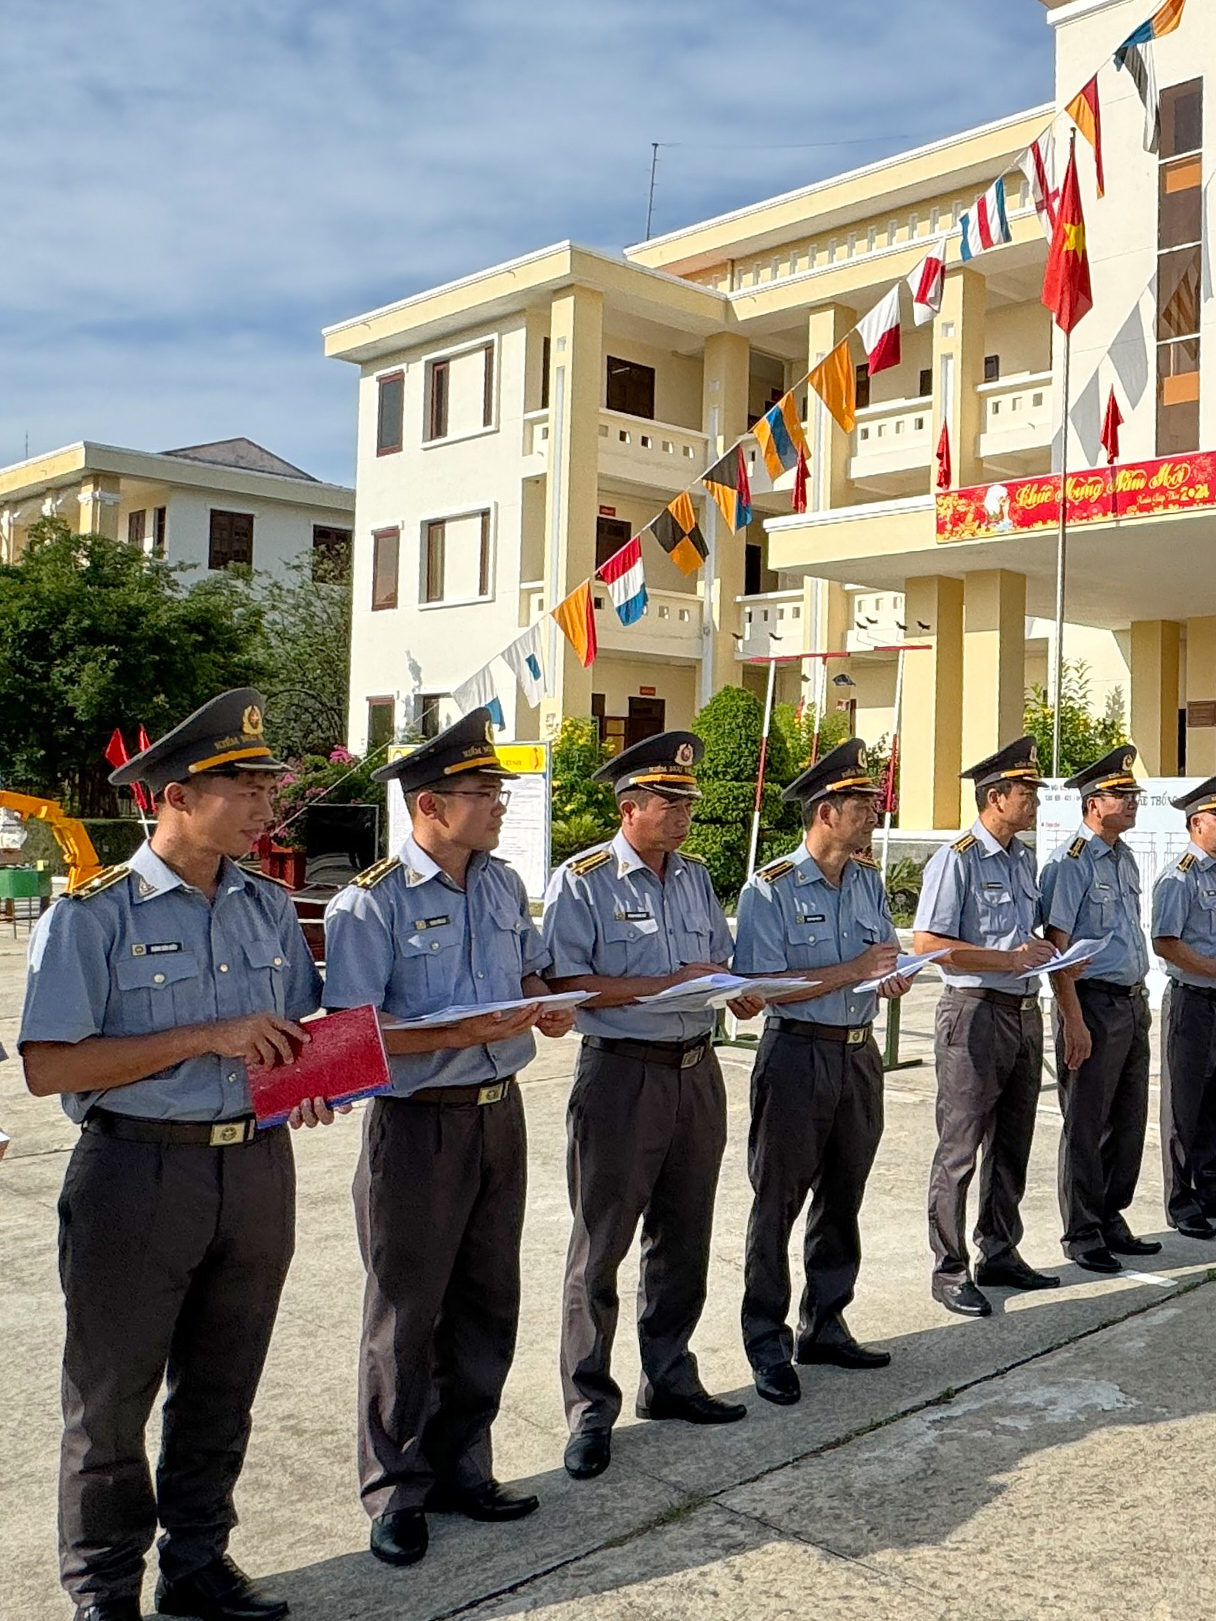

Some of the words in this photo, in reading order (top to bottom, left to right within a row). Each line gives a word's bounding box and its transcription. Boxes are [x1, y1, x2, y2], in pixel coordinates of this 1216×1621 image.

[1016, 484, 1054, 509] Chúc
[1055, 476, 1104, 504] Mừng
[1106, 469, 1147, 494] Năm
[1148, 462, 1191, 489] Mới
